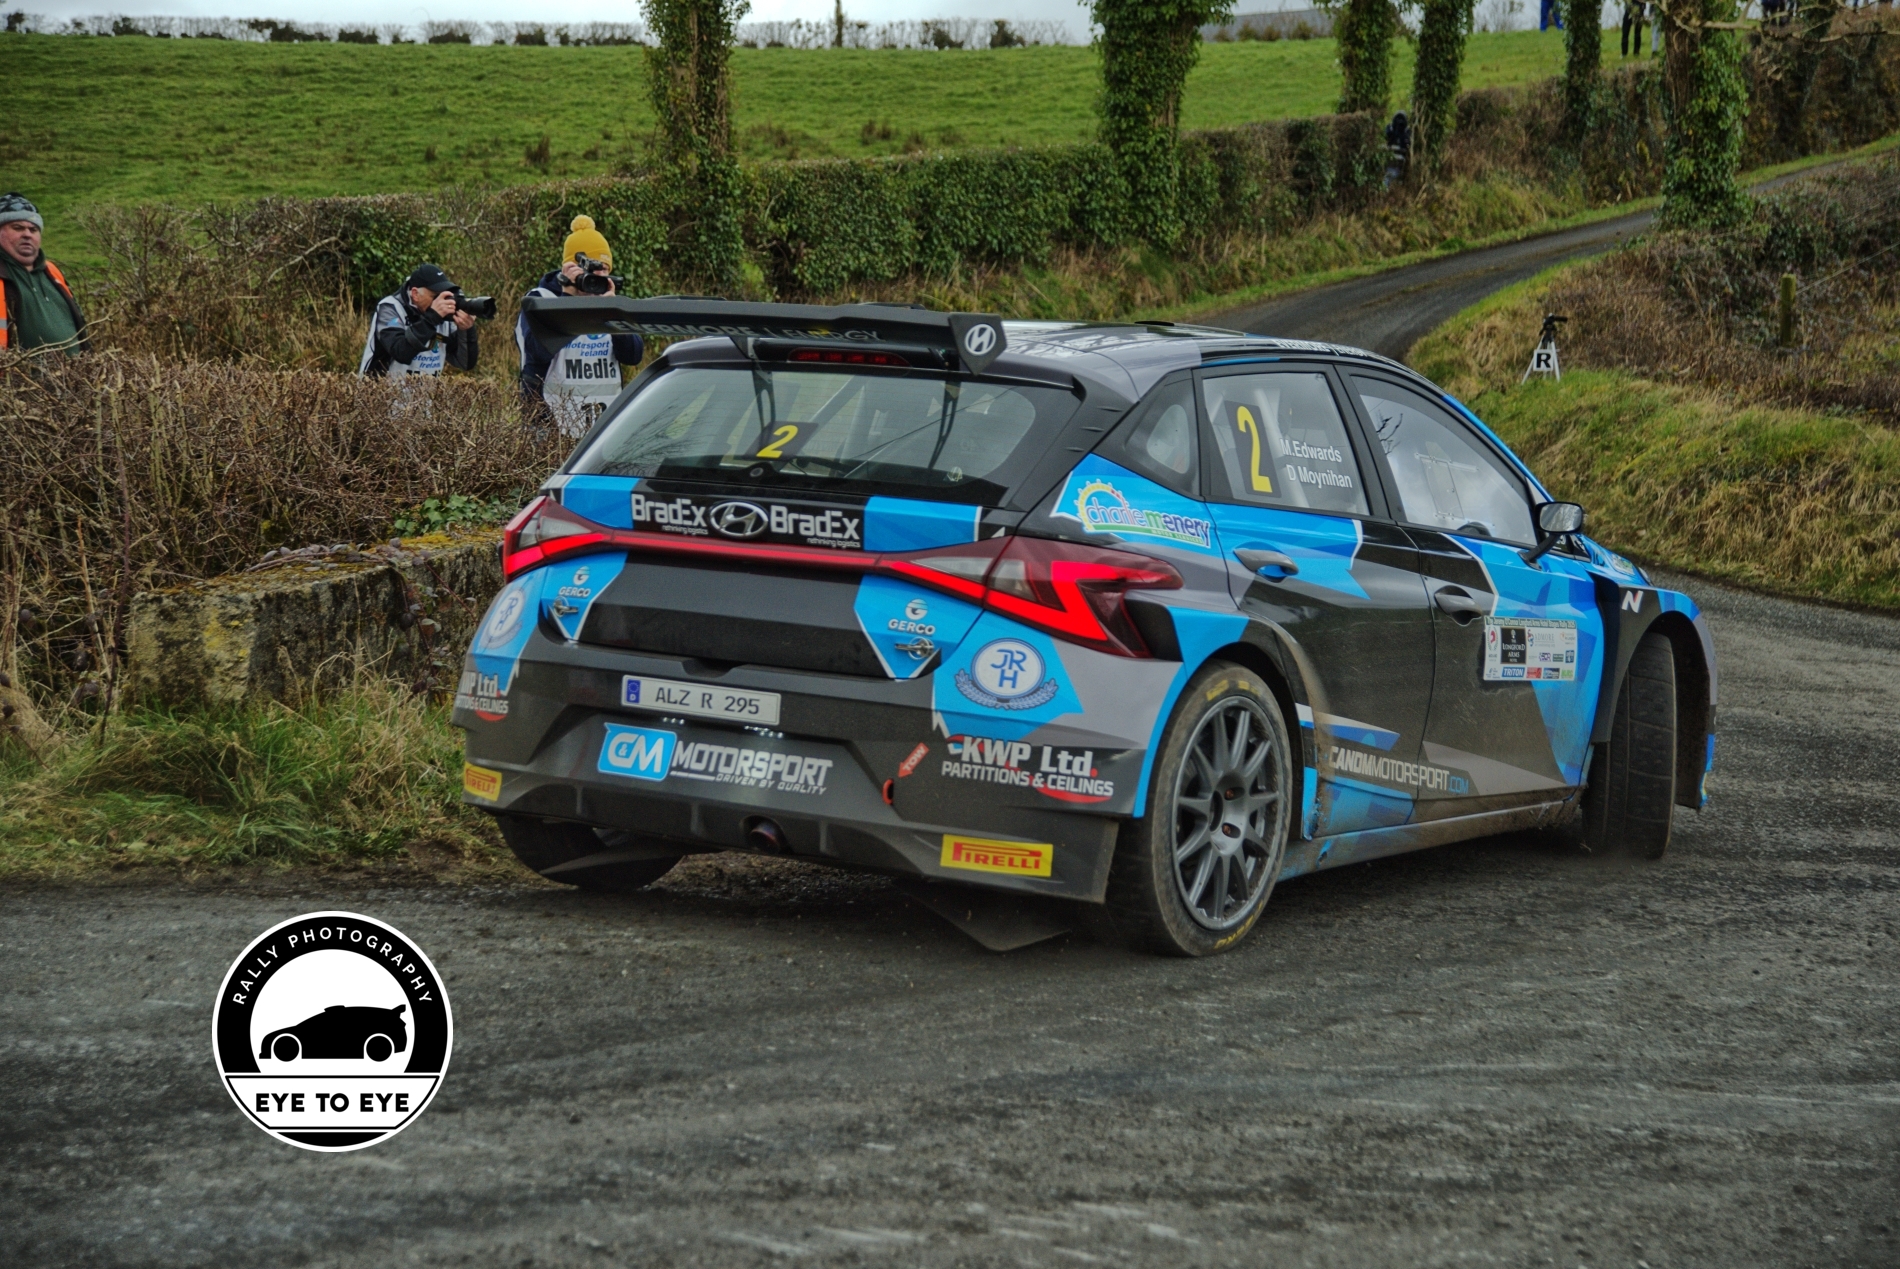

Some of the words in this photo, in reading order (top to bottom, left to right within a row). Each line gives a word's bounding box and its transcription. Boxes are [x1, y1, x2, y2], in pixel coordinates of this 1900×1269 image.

[565, 358, 617, 380] Media
[1536, 352, 1551, 369] R
[755, 424, 799, 459] 2
[1237, 405, 1273, 493] 2
[1280, 438, 1343, 463] M.Edwards
[1286, 464, 1296, 481] D
[1298, 465, 1353, 489] Moynihan
[630, 493, 708, 528] BradEx
[770, 504, 861, 541] BradEx
[558, 586, 592, 598] GERCO
[1621, 590, 1644, 614] N
[887, 618, 937, 637] GERCO
[1504, 668, 1524, 677] TRITON
[655, 686, 692, 707] ALZ
[701, 692, 714, 710] R
[724, 695, 761, 715] 295
[671, 740, 833, 787] MOTORSPORT
[902, 745, 927, 772] TOW
[960, 735, 1032, 769] KWP
[1039, 745, 1099, 778] Ltd.
[714, 773, 757, 787] DRIVEN
[758, 778, 775, 789] BY
[777, 781, 828, 796] QUALITY
[941, 759, 1030, 788] PARTITIONS
[1032, 772, 1045, 788] &
[1046, 774, 1115, 797] CEILINGS
[952, 840, 1043, 870] PIRELLI
